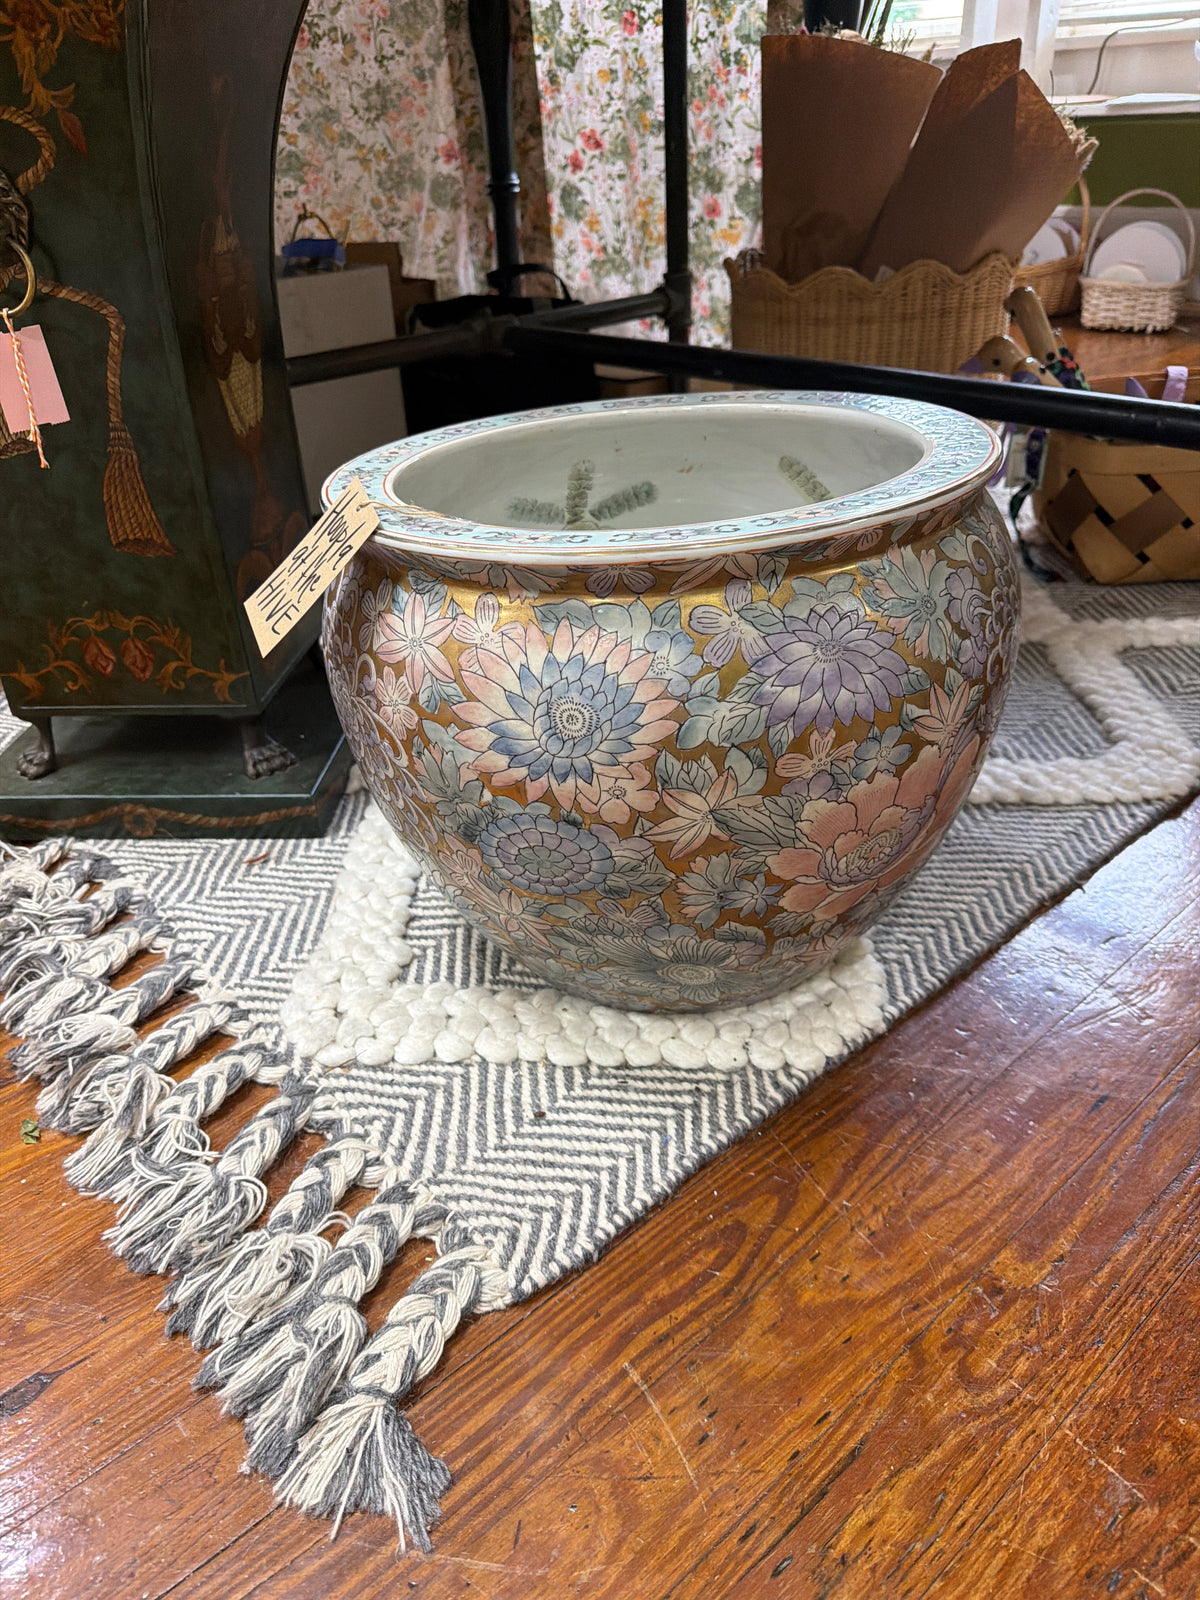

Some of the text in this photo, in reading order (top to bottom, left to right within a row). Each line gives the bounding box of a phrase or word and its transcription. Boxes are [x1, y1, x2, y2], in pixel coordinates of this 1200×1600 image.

[256, 567, 299, 635] HIVE
[288, 545, 328, 604] at the
